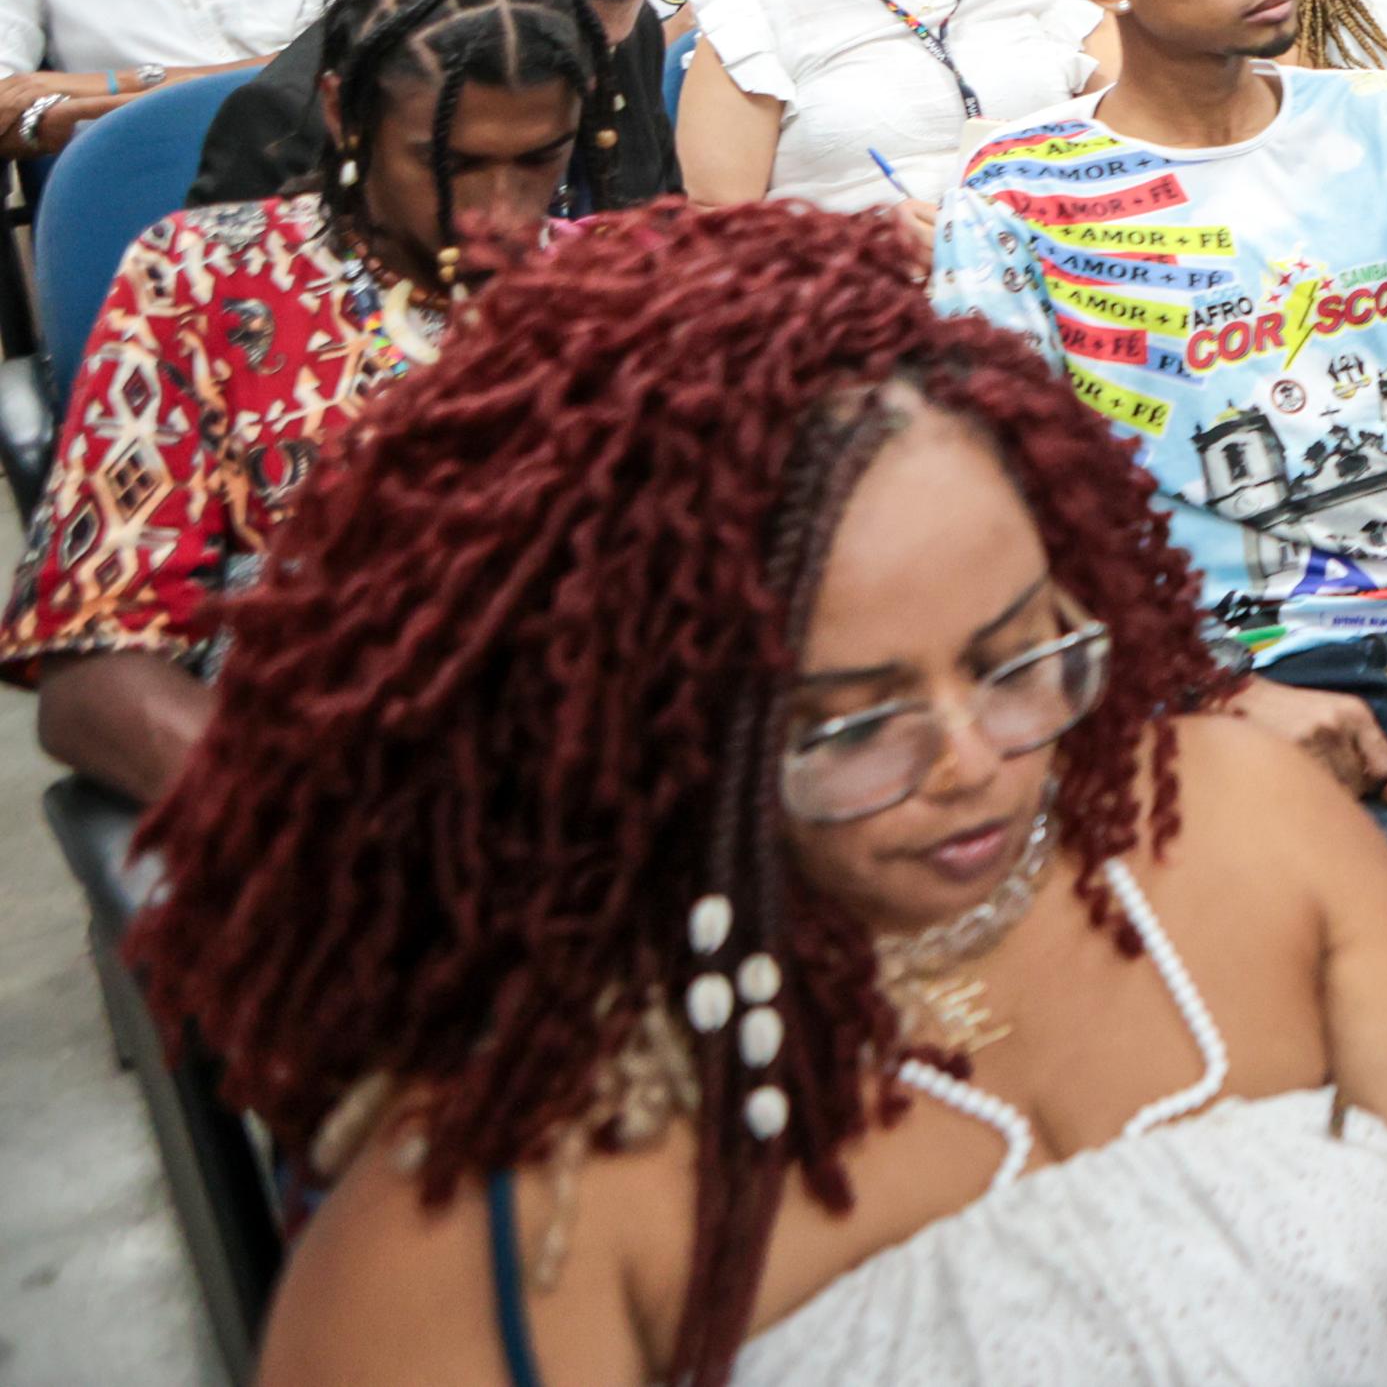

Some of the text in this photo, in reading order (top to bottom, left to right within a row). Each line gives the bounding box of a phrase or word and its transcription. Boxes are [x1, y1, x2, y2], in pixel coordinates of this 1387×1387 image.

[1038, 160, 1128, 183] AMOR
[1056, 196, 1126, 220] AMOR
[1149, 177, 1179, 204] FÉ
[1080, 226, 1168, 247] AMOR
[1199, 228, 1233, 249] FÉ
[1062, 254, 1151, 284] AMOR
[1069, 290, 1147, 325] AMOR
[1193, 296, 1254, 330] AFRO
